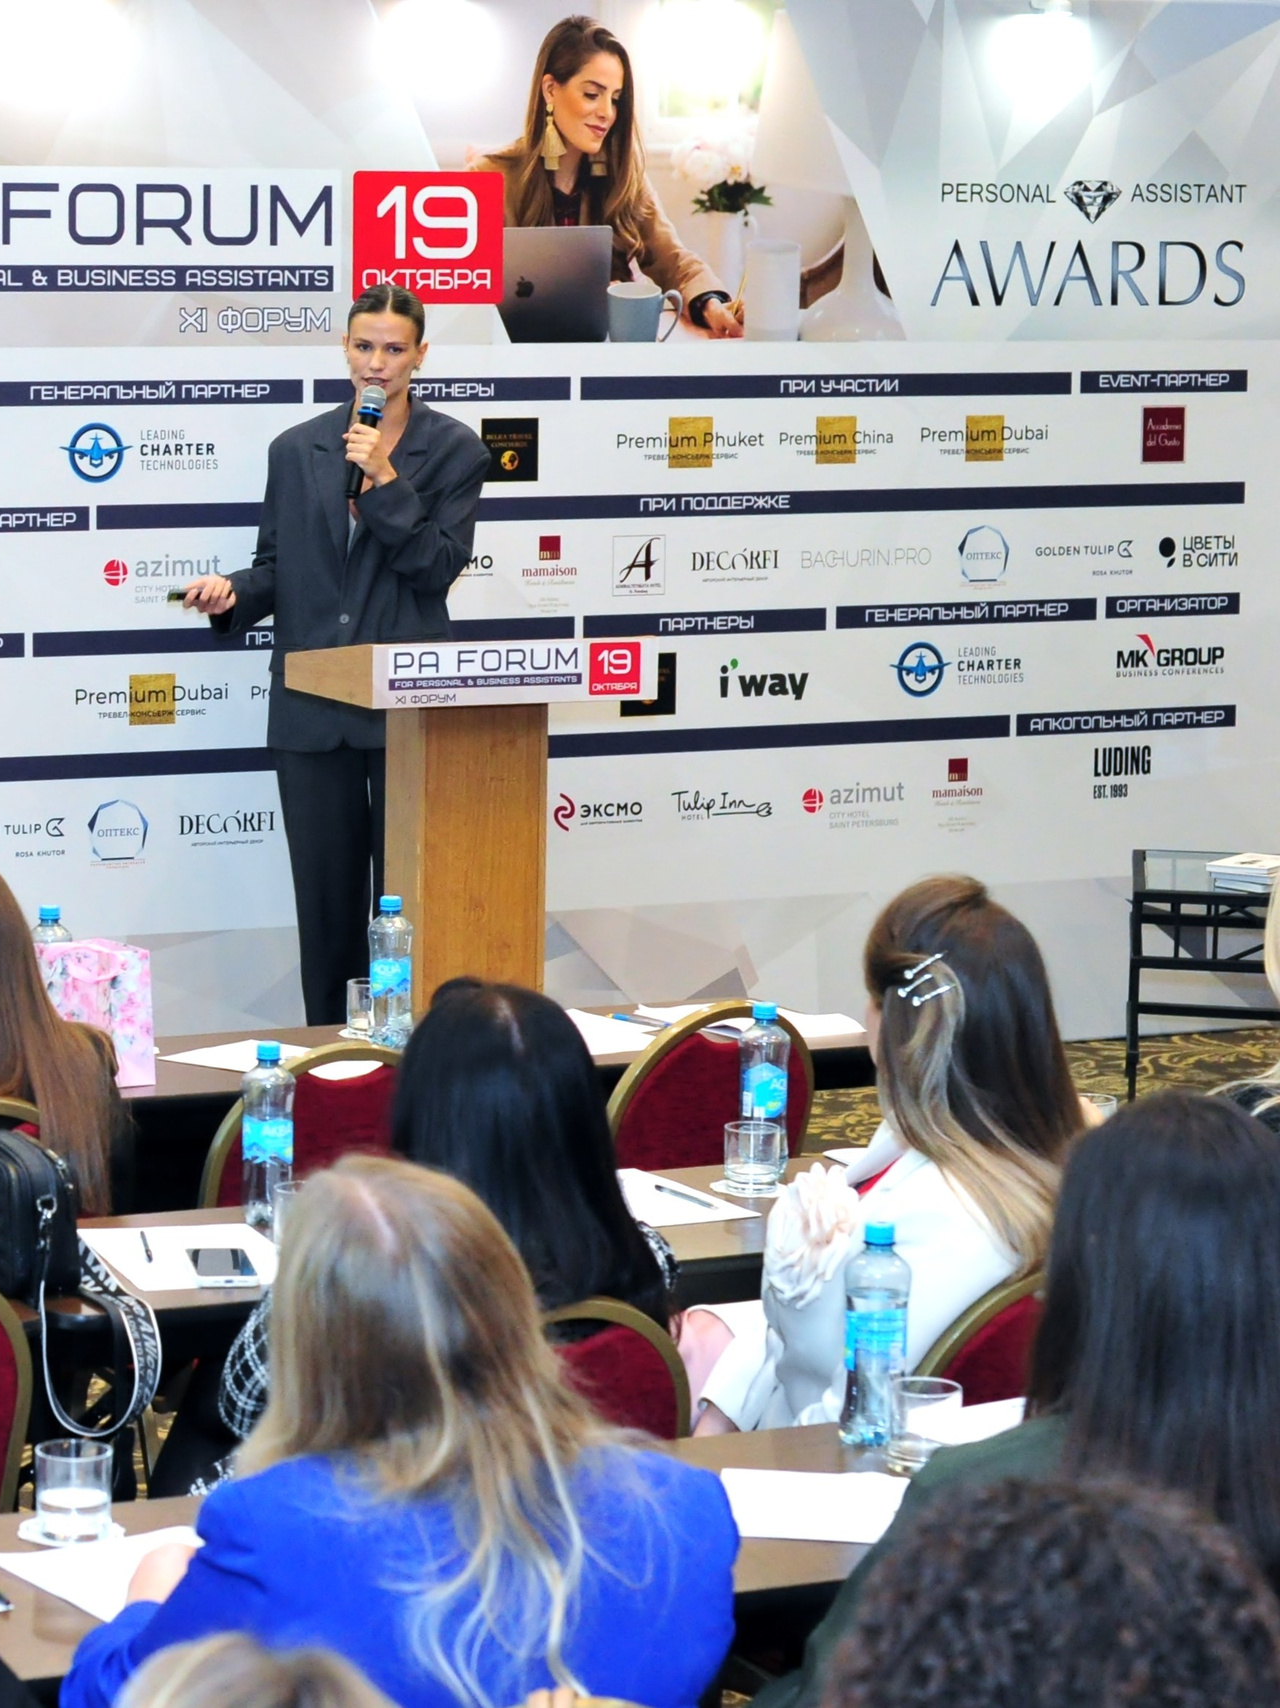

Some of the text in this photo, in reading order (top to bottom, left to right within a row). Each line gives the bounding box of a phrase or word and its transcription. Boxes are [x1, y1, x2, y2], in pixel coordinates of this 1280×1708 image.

[941, 183, 1247, 204] PERSONAL ASSISTANT
[2, 183, 333, 246] FORUM
[376, 186, 478, 260] 19
[32, 269, 48, 286] &
[57, 269, 177, 287] BUSINESS
[185, 269, 330, 287] ASSISTANTS
[362, 268, 491, 290] ОКТЯБРЯ
[930, 239, 1246, 307] AWARDS
[217, 306, 331, 333] ФОРУМ
[780, 379, 899, 394] ПРИ УЧАСТИИ
[1098, 373, 1230, 388] EVENT-ПАРТНЕР
[30, 381, 270, 400] ГЕНЕРАЛЬНЫЙ ПАРТНЕР
[408, 383, 495, 398] АРТНЕРЫ
[140, 429, 185, 441] LEADING
[616, 431, 765, 449] Premium Phuket
[779, 430, 894, 446] Premium China
[920, 425, 1049, 443] Premium Dubai
[140, 443, 216, 457] CHARTER
[141, 459, 219, 471] TECHNOLOGIES
[640, 495, 791, 512] ПРИ ПОДДЕРЖКЕ
[1035, 545, 1115, 557] GOLDEN TULIP
[1183, 535, 1235, 554] ЦВЕТЫ
[135, 553, 221, 578] azimut
[800, 547, 932, 569] BACHURIN.PRO
[1182, 552, 1239, 568] В СИТИ
[521, 564, 578, 578] mamaison
[865, 602, 1070, 623] ГЕНЕРАЛЬНЫЙ ПАРТНЕР
[1116, 596, 1229, 613] ОРГАНИЗАТОР
[659, 615, 755, 632] ПАРТНЕРЫ
[245, 631, 275, 646] ПР
[958, 646, 997, 658] LEADING
[1116, 646, 1225, 669] MK GROUP
[394, 647, 579, 675] PA FORUM
[597, 648, 632, 675] 19
[957, 658, 1022, 672] CHARTER
[957, 672, 1024, 686] TECHNOLOGIES
[1116, 666, 1225, 678] BUSINESS CONFERENCES
[395, 681, 414, 689] FOR
[416, 679, 465, 688] PERSONAL
[476, 677, 521, 686] BUSINESS
[523, 675, 578, 684] ASSISTANTS
[591, 682, 638, 692] ОКТЯБРЯ
[74, 686, 167, 706] Premium
[172, 682, 229, 702] Dubai
[410, 693, 457, 704] ФОРУМ
[1030, 710, 1226, 732] АЛКОГОЛЬНЫЙ ПАРТНЕР
[1093, 745, 1152, 777] LUDING
[830, 781, 905, 805] azimut
[932, 785, 983, 799] mamaison
[1093, 783, 1128, 800] EST. 1993
[580, 801, 643, 819] ЭКСМО
[671, 790, 756, 819] Tulip Inn
[4, 823, 42, 836] TULIP
[97, 827, 140, 838] ОПТЕКС
